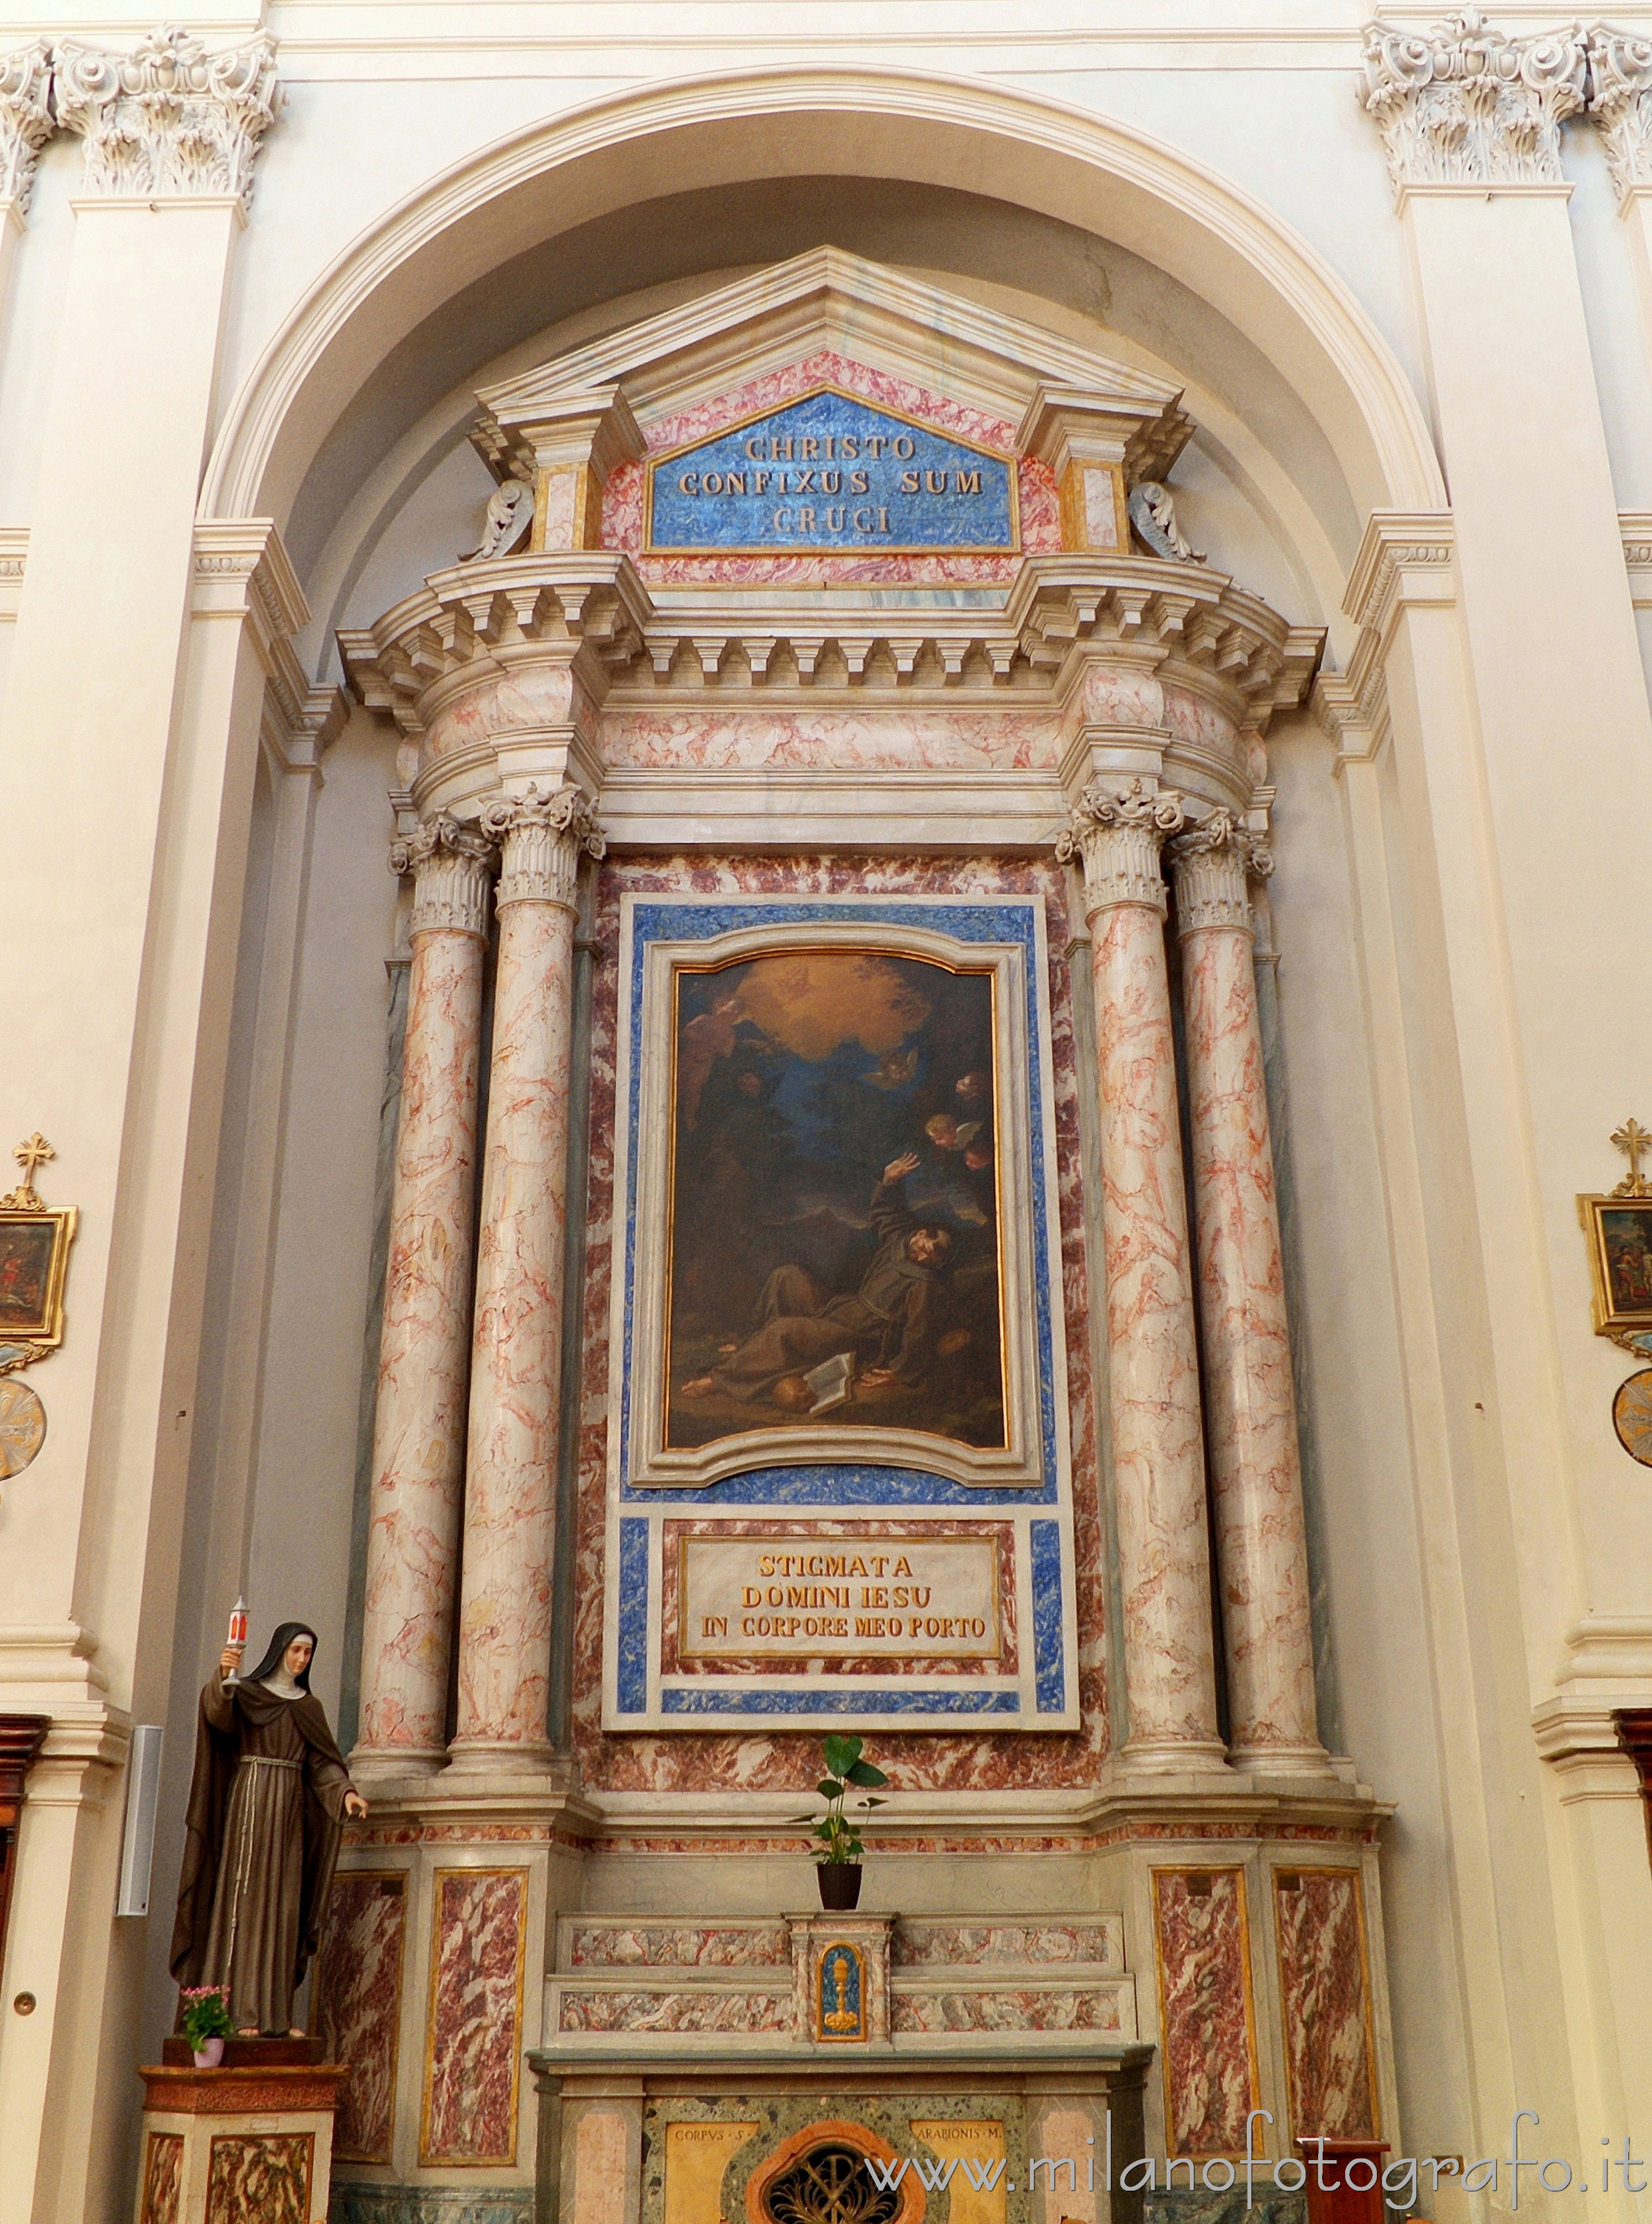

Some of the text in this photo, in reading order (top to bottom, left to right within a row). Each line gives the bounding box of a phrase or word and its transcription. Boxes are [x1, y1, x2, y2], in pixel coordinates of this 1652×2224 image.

[745, 436, 915, 462] CHRISTO
[680, 471, 982, 495] CONFIXUS SUM
[774, 508, 890, 533] CRUCI
[759, 1555, 912, 1577] STIGMATA
[742, 1586, 931, 1609] DOMINI IESU
[702, 1616, 985, 1638] IN CORPORE MEO PORTO
[675, 2130, 724, 2140] CORPVS
